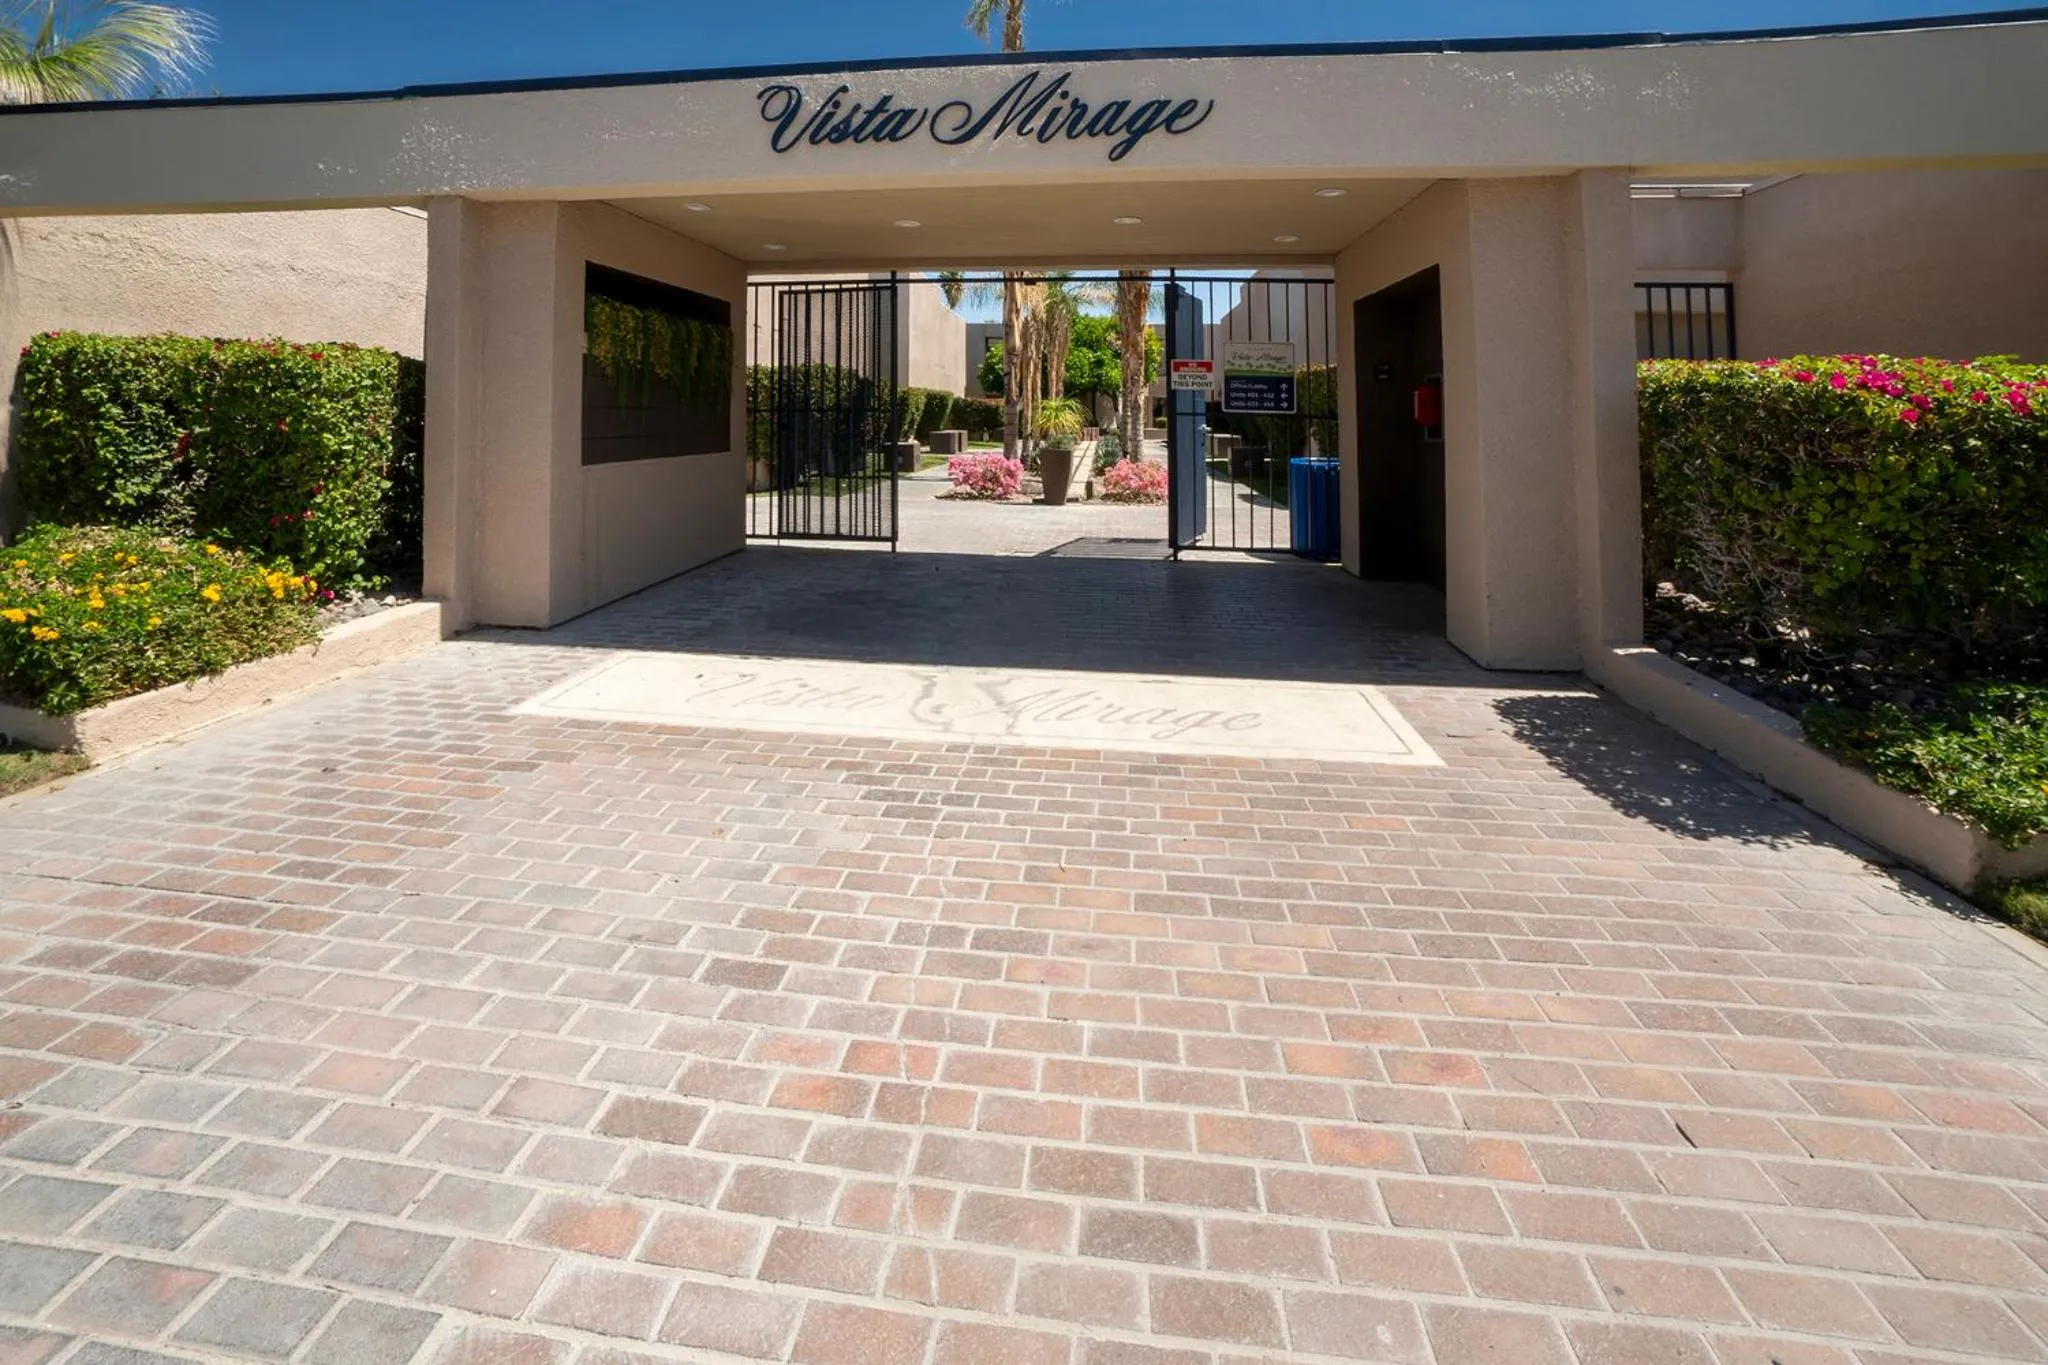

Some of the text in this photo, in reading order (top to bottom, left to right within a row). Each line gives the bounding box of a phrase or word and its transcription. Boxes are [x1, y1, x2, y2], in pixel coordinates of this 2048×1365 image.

[756, 70, 1215, 162] Vista Mirage
[968, 687, 1263, 740] Mirage
